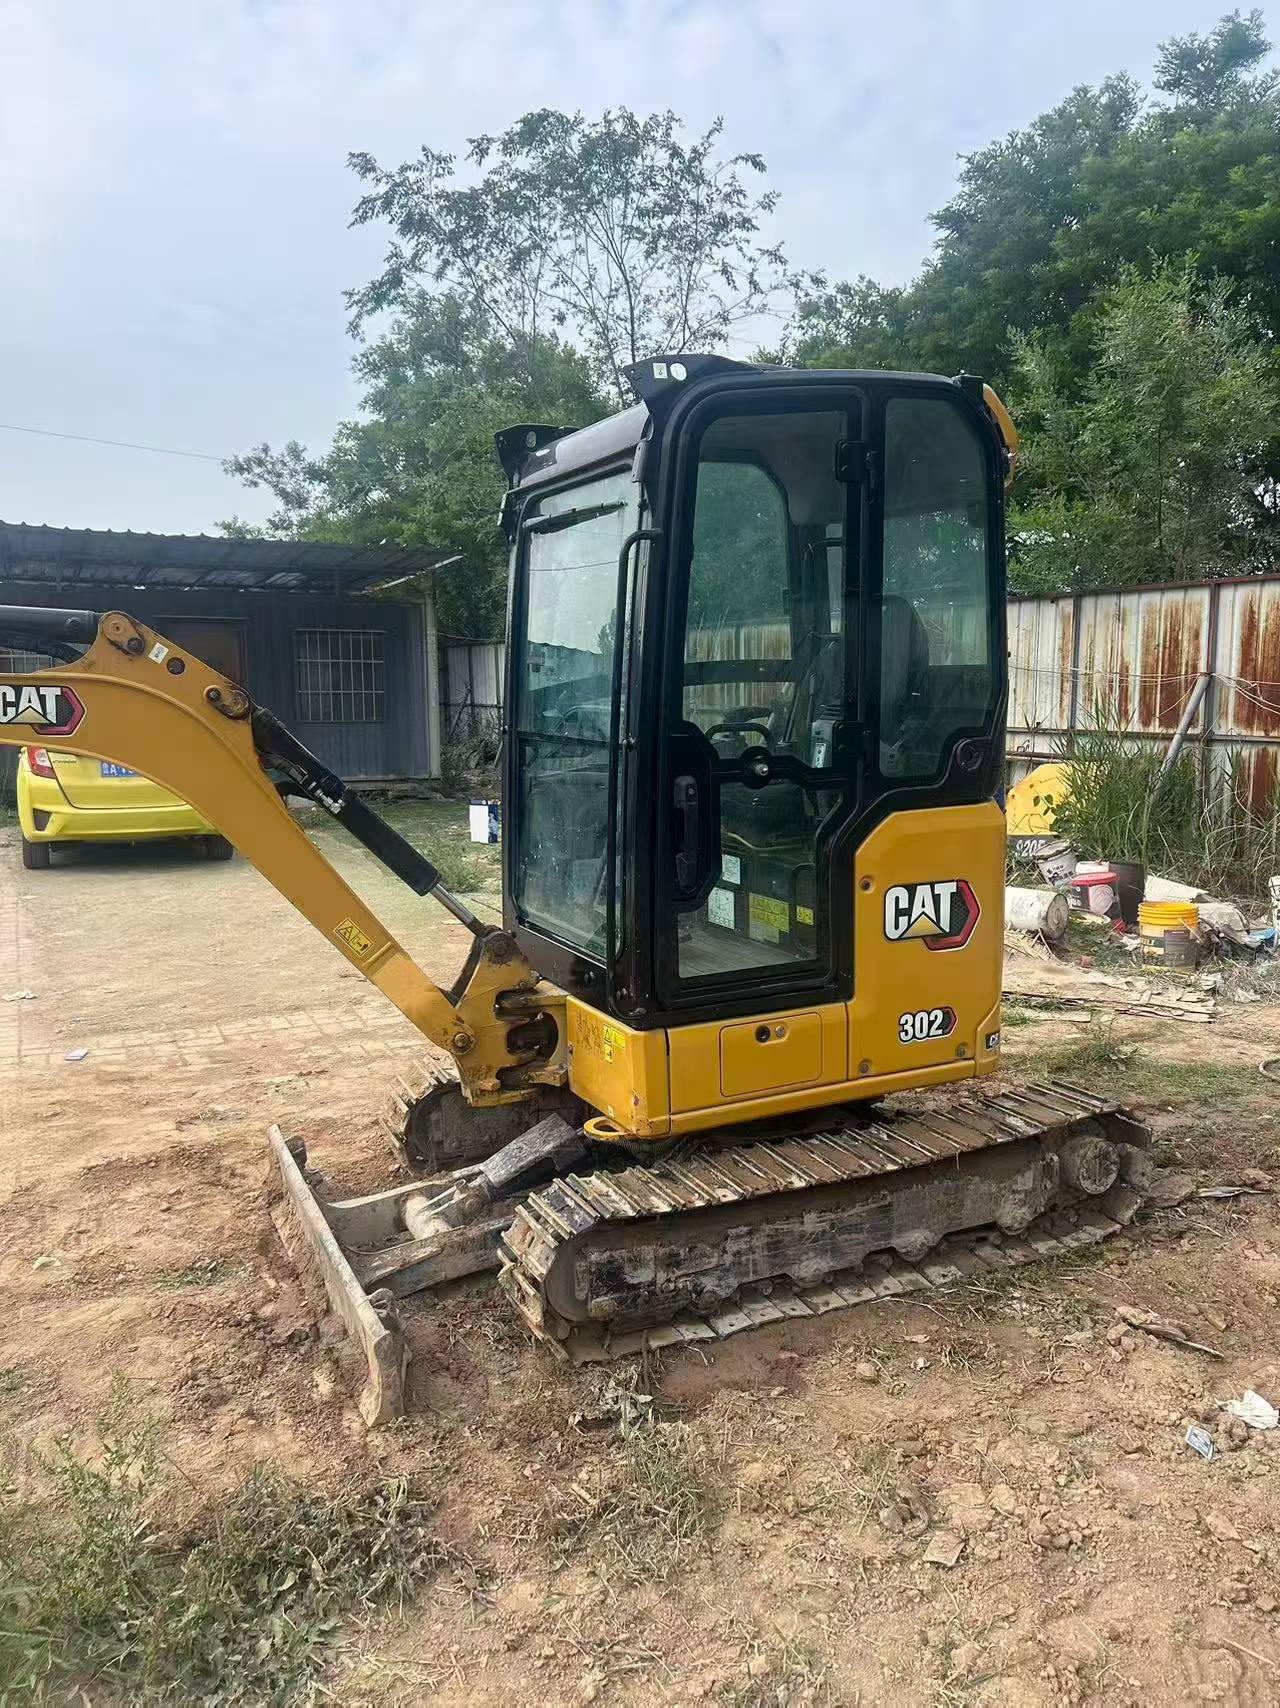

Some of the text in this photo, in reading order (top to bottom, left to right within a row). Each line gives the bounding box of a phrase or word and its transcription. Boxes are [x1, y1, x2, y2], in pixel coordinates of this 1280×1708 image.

[0, 686, 61, 724] CAT
[885, 881, 957, 940] CAT
[899, 1009, 944, 1041] 302
